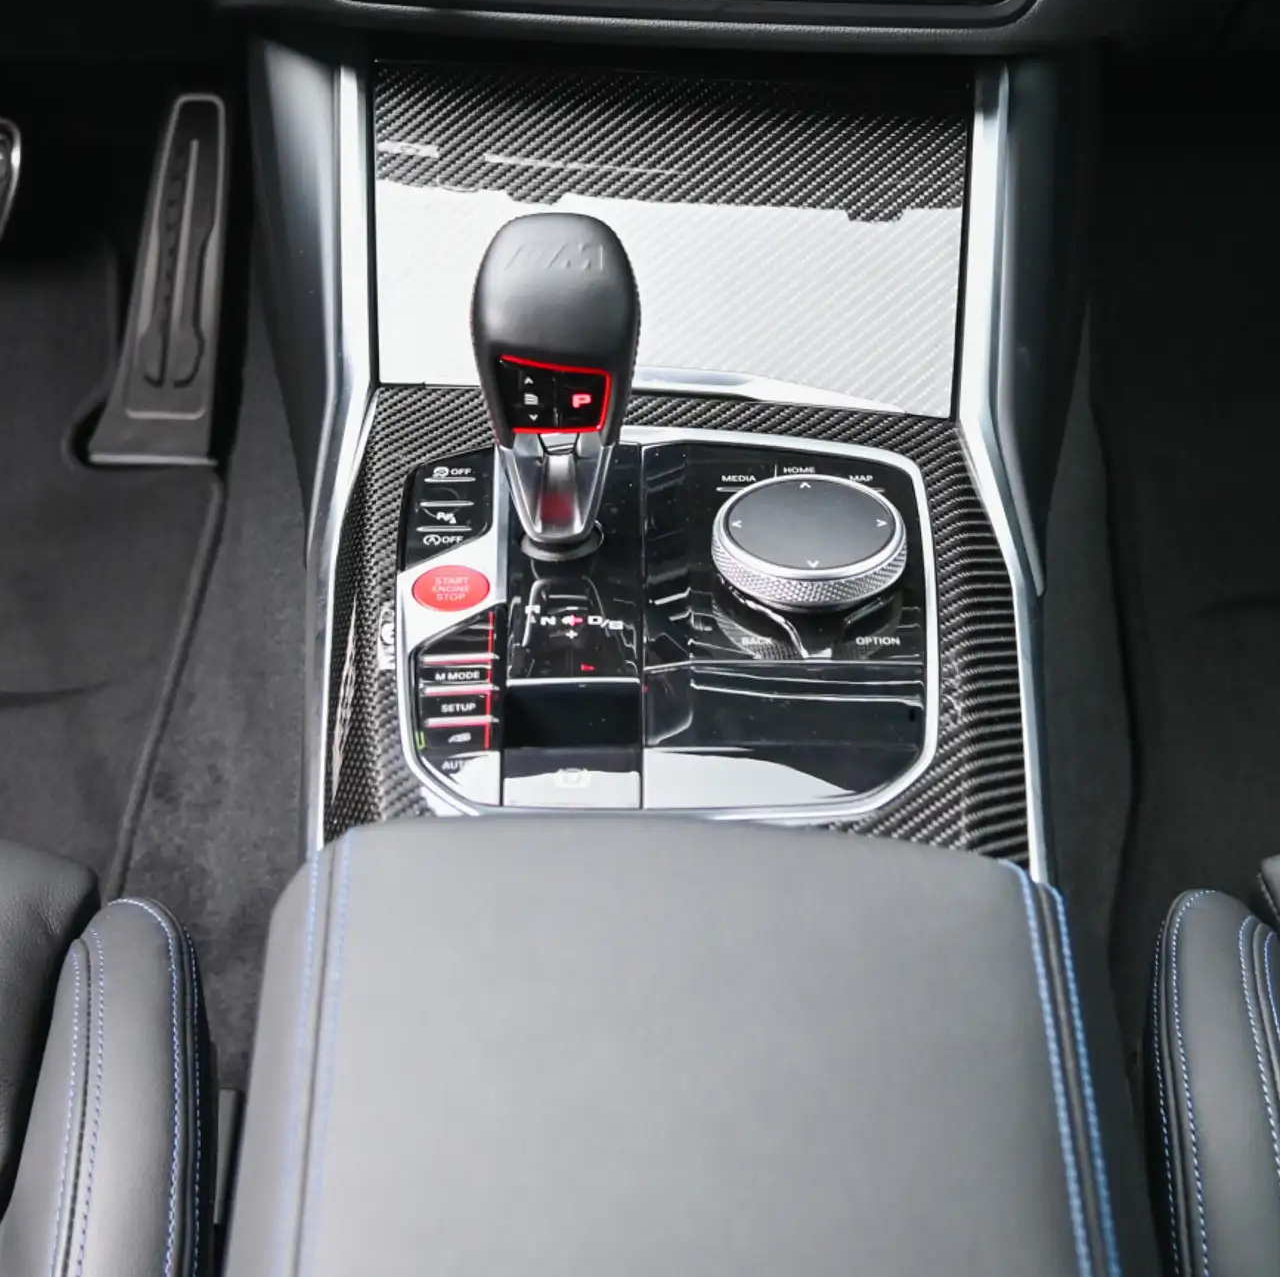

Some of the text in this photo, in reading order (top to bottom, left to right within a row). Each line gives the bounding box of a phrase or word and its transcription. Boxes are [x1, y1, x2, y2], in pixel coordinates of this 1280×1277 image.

[571, 393, 592, 409] P
[450, 467, 473, 476] OFF
[782, 466, 816, 474] HOME
[721, 474, 757, 483] MEDIA
[441, 535, 465, 545] OFF
[434, 576, 469, 585] START
[431, 584, 469, 593] ENGINE
[435, 592, 467, 601] STOP
[540, 615, 557, 626] N
[855, 636, 901, 646] OPTION
[434, 671, 480, 681] M MODE
[440, 703, 477, 713] SETUP
[441, 760, 472, 771] AUT
